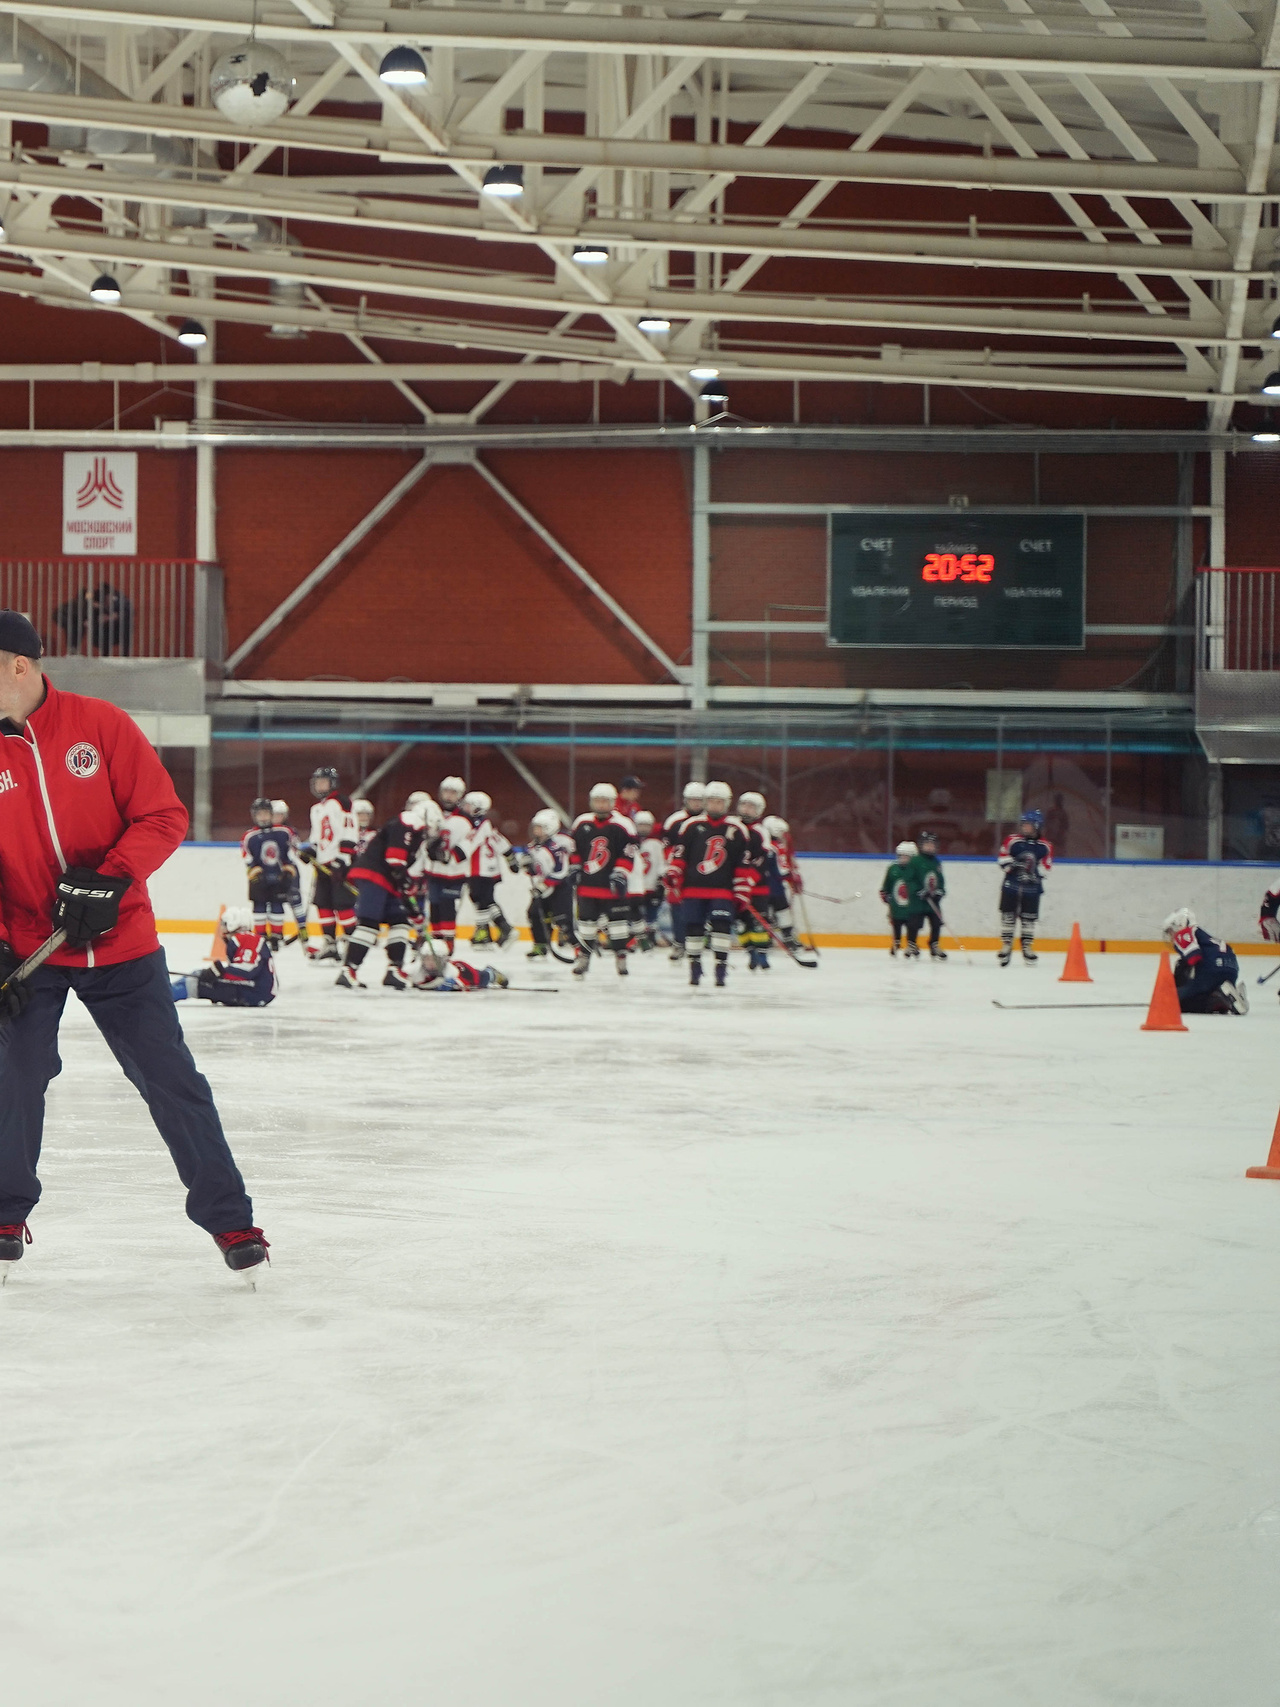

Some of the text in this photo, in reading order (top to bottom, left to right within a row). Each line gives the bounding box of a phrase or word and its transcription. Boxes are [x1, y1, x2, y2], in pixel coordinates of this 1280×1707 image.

[66, 518, 133, 533] МОСКОВСКИЙ
[83, 536, 115, 549] СПОРТ
[1020, 539, 1052, 552] СЧЕТ
[922, 553, 995, 582] 20:52
[59, 882, 114, 898] EFSI
